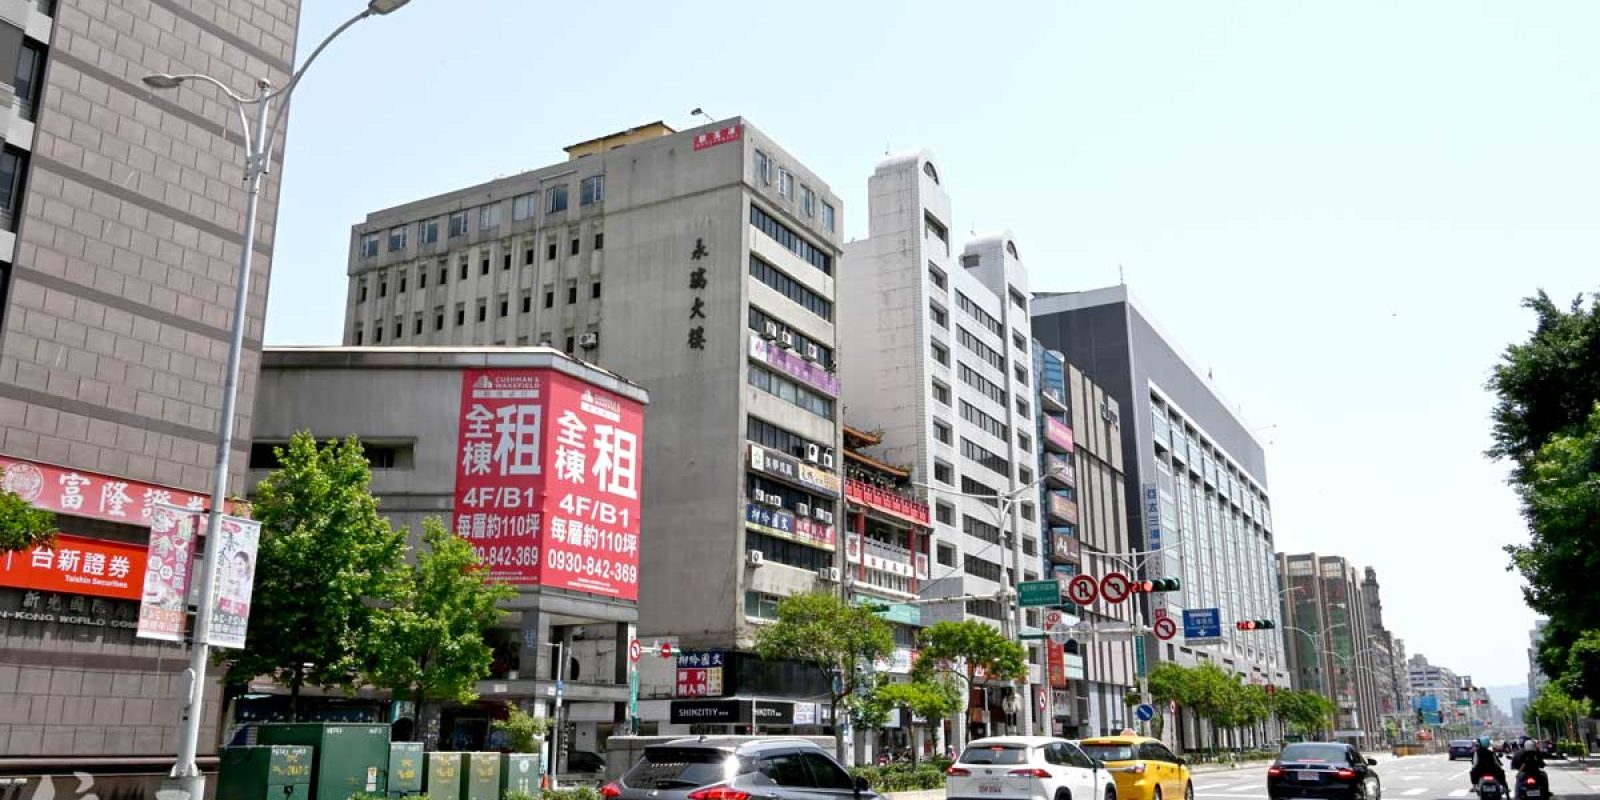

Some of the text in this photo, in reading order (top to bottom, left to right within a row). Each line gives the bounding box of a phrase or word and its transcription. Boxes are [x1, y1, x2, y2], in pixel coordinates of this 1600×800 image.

[462, 403, 494, 476] 全棟
[494, 404, 542, 476] 租
[554, 410, 587, 484] 全棟
[592, 424, 637, 500] 租
[463, 487, 534, 508] 4F/B1
[559, 494, 629, 527] 4F/B1
[457, 512, 540, 539] 每層約110坪
[551, 517, 637, 558] 每層約110坪
[31, 548, 131, 579] 台新證券
[548, 549, 637, 584] 0930-842-369
[64, 574, 128, 589] Taishin Securities
[59, 615, 106, 626] WORLD
